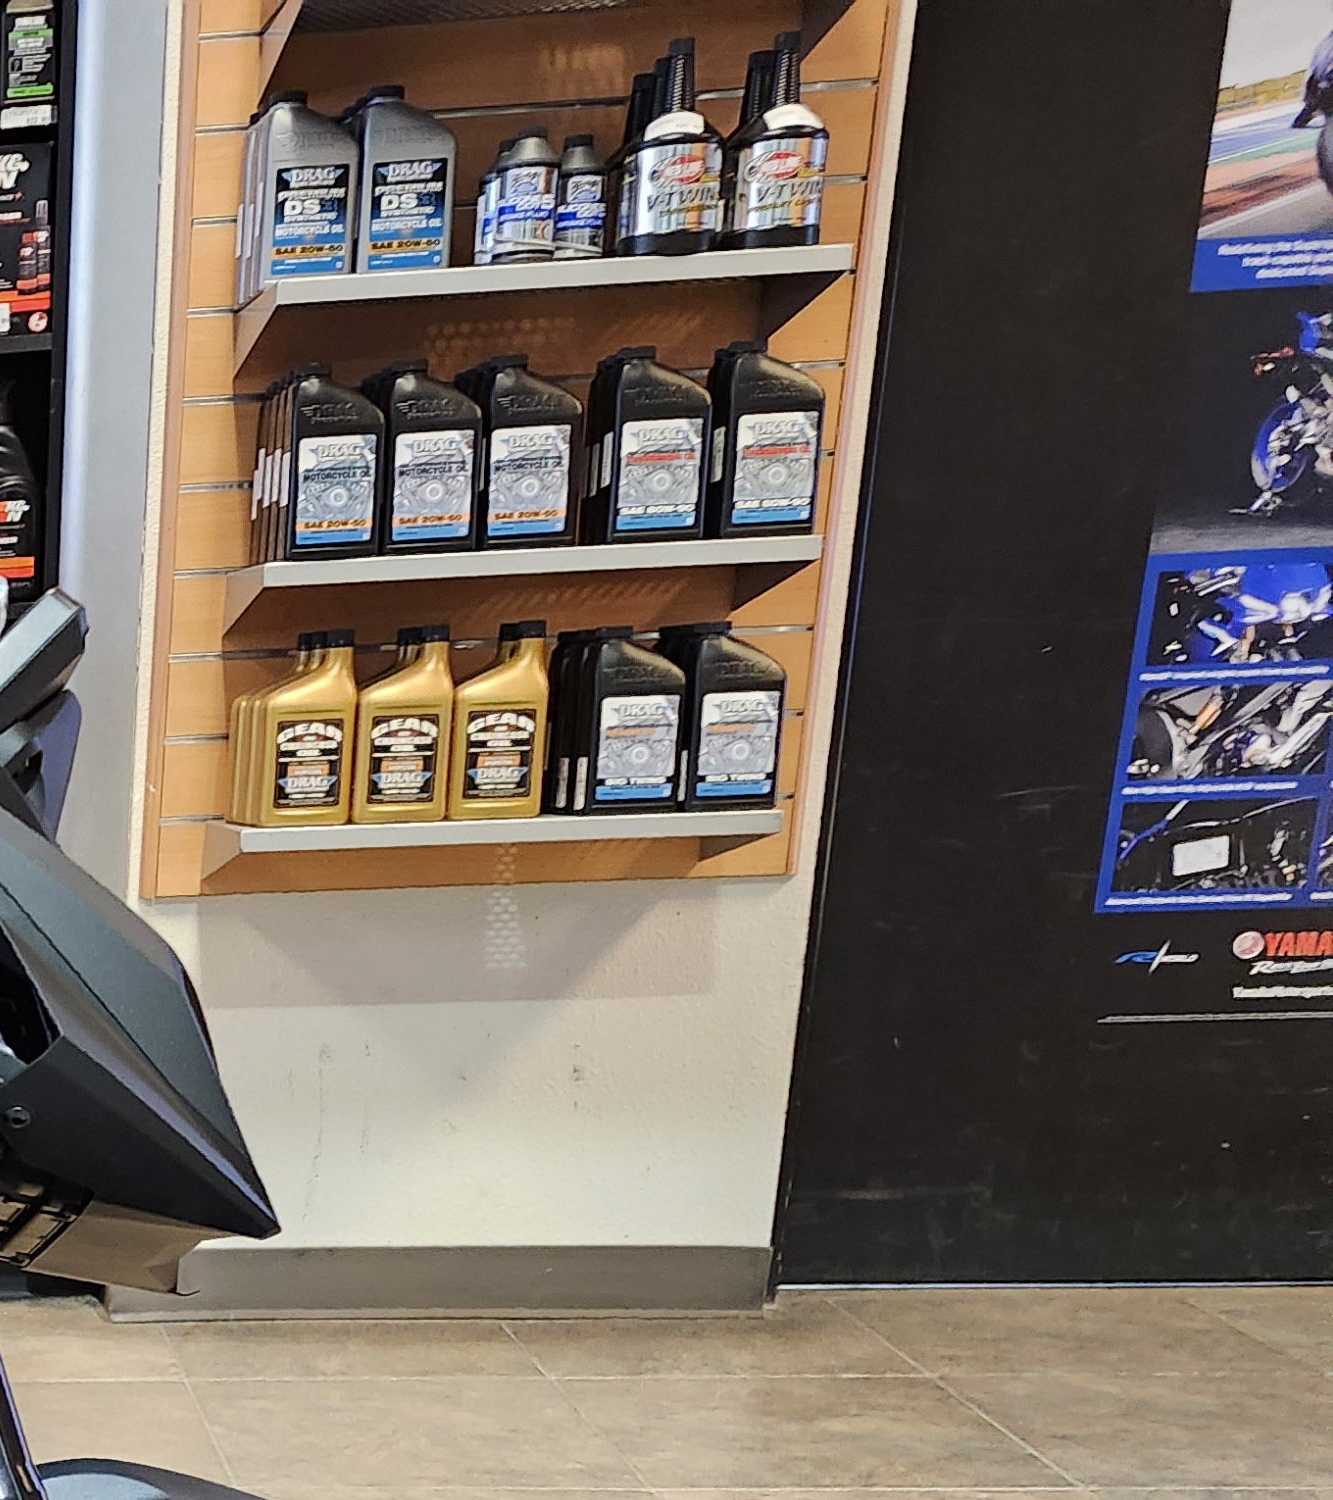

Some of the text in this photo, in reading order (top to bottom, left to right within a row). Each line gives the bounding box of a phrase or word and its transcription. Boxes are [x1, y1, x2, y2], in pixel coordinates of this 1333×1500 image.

[292, 167, 335, 183] DRAG
[389, 161, 433, 178] DRAG
[413, 438, 458, 453] DRAG
[509, 434, 554, 447] DRAG
[317, 443, 362, 458] DRAG
[399, 467, 453, 477] MOTORCYCLE
[494, 462, 549, 473] MOTORCYCLE
[303, 471, 357, 482] MOTORCYCLE
[399, 517, 419, 525] SAE
[494, 511, 514, 519] SAE
[304, 521, 324, 529] SAE
[371, 718, 439, 739] GEAR
[466, 713, 535, 734] GEAR
[276, 721, 344, 744] GEAR
[382, 772, 423, 784] DRAG
[476, 767, 520, 779] DRAG
[287, 777, 329, 789] DRAG
[1264, 930, 1333, 957] YAMA
